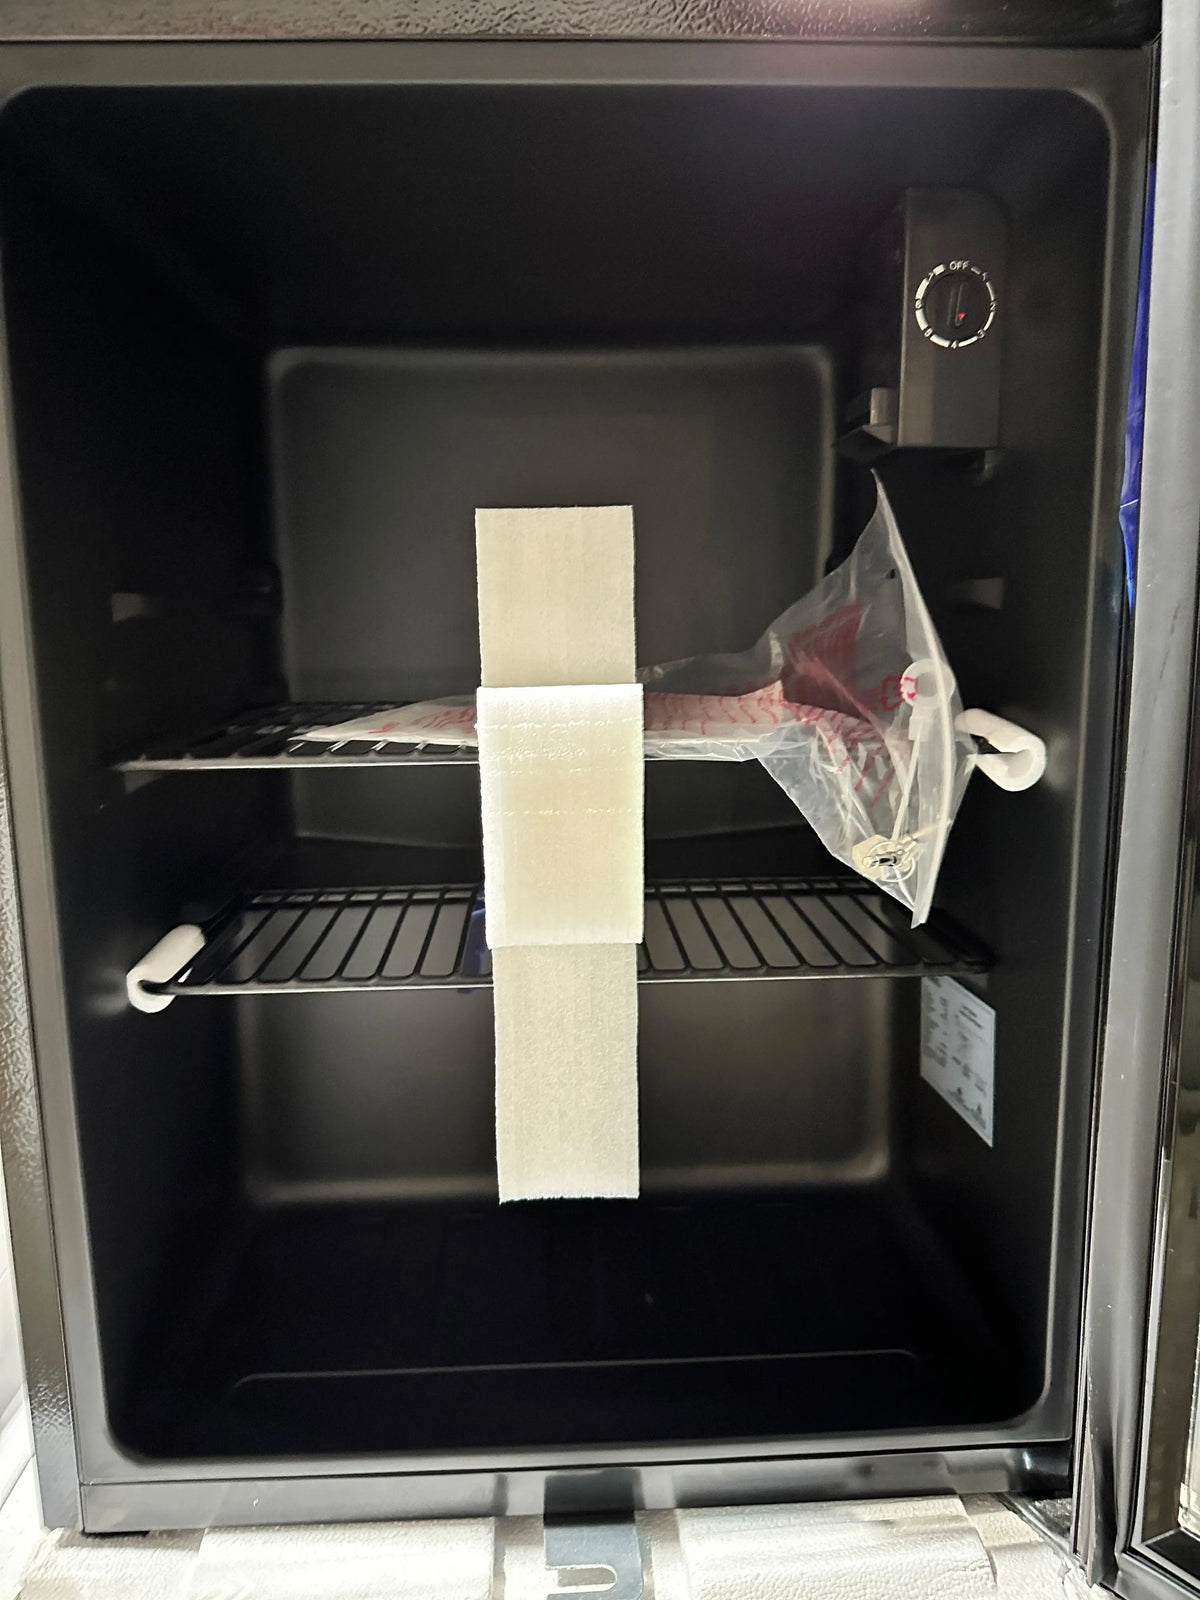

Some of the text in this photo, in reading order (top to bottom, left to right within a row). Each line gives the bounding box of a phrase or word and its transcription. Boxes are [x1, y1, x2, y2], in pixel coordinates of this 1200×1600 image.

[949, 260, 969, 271] OFF
[982, 271, 989, 281] 1
[990, 302, 998, 311] 2
[977, 329, 985, 338] 3
[951, 340, 958, 349] 4
